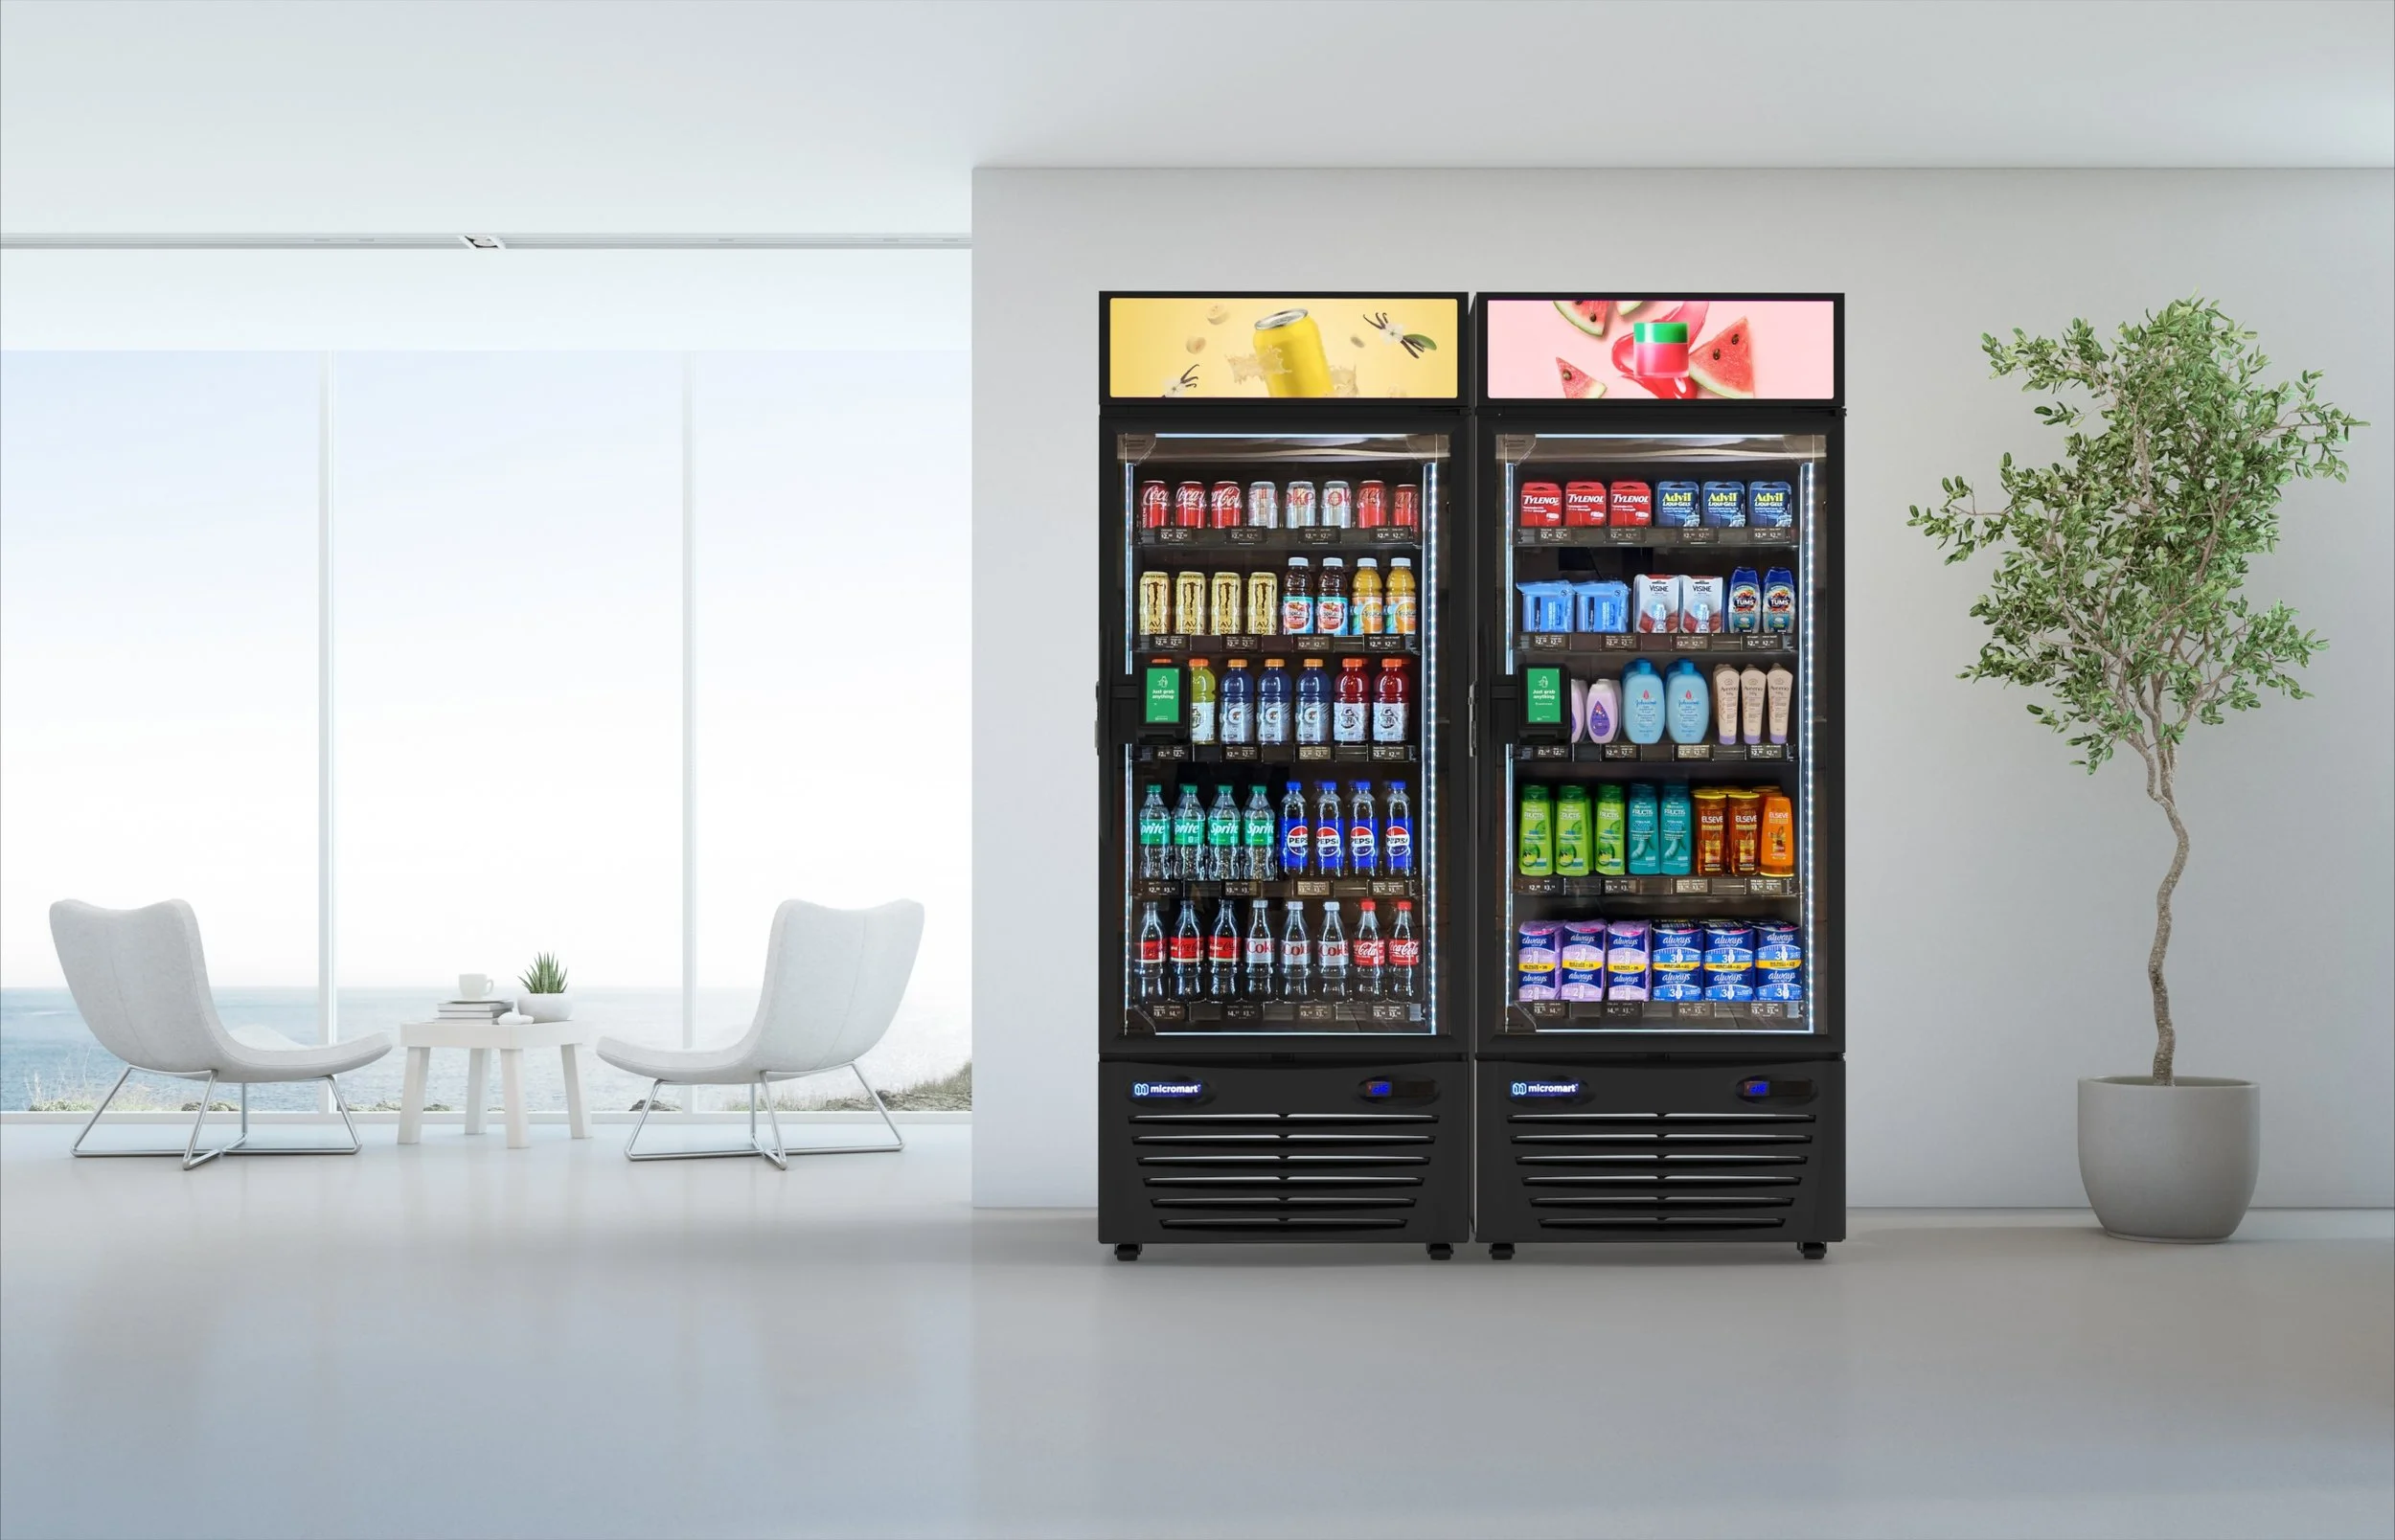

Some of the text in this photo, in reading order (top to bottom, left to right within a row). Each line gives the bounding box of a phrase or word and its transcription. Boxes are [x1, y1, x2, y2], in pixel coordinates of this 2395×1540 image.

[1567, 494, 1604, 503] TYLENOL
[1612, 494, 1649, 503] TYLENOL
[1662, 492, 1692, 502] Advil
[1707, 492, 1738, 502] Advil
[1754, 492, 1785, 502] Advil
[1701, 815, 1723, 824] ELSEVE
[1140, 823, 1166, 835] prite
[1175, 823, 1199, 834] prite
[1662, 936, 1692, 947] always
[1715, 935, 1744, 947] always
[1767, 932, 1794, 943] always
[1662, 973, 1691, 984] always
[1714, 972, 1743, 984] always
[1768, 972, 1796, 983] always
[1151, 1084, 1198, 1093] micromart
[1528, 1083, 1576, 1093] micromart
